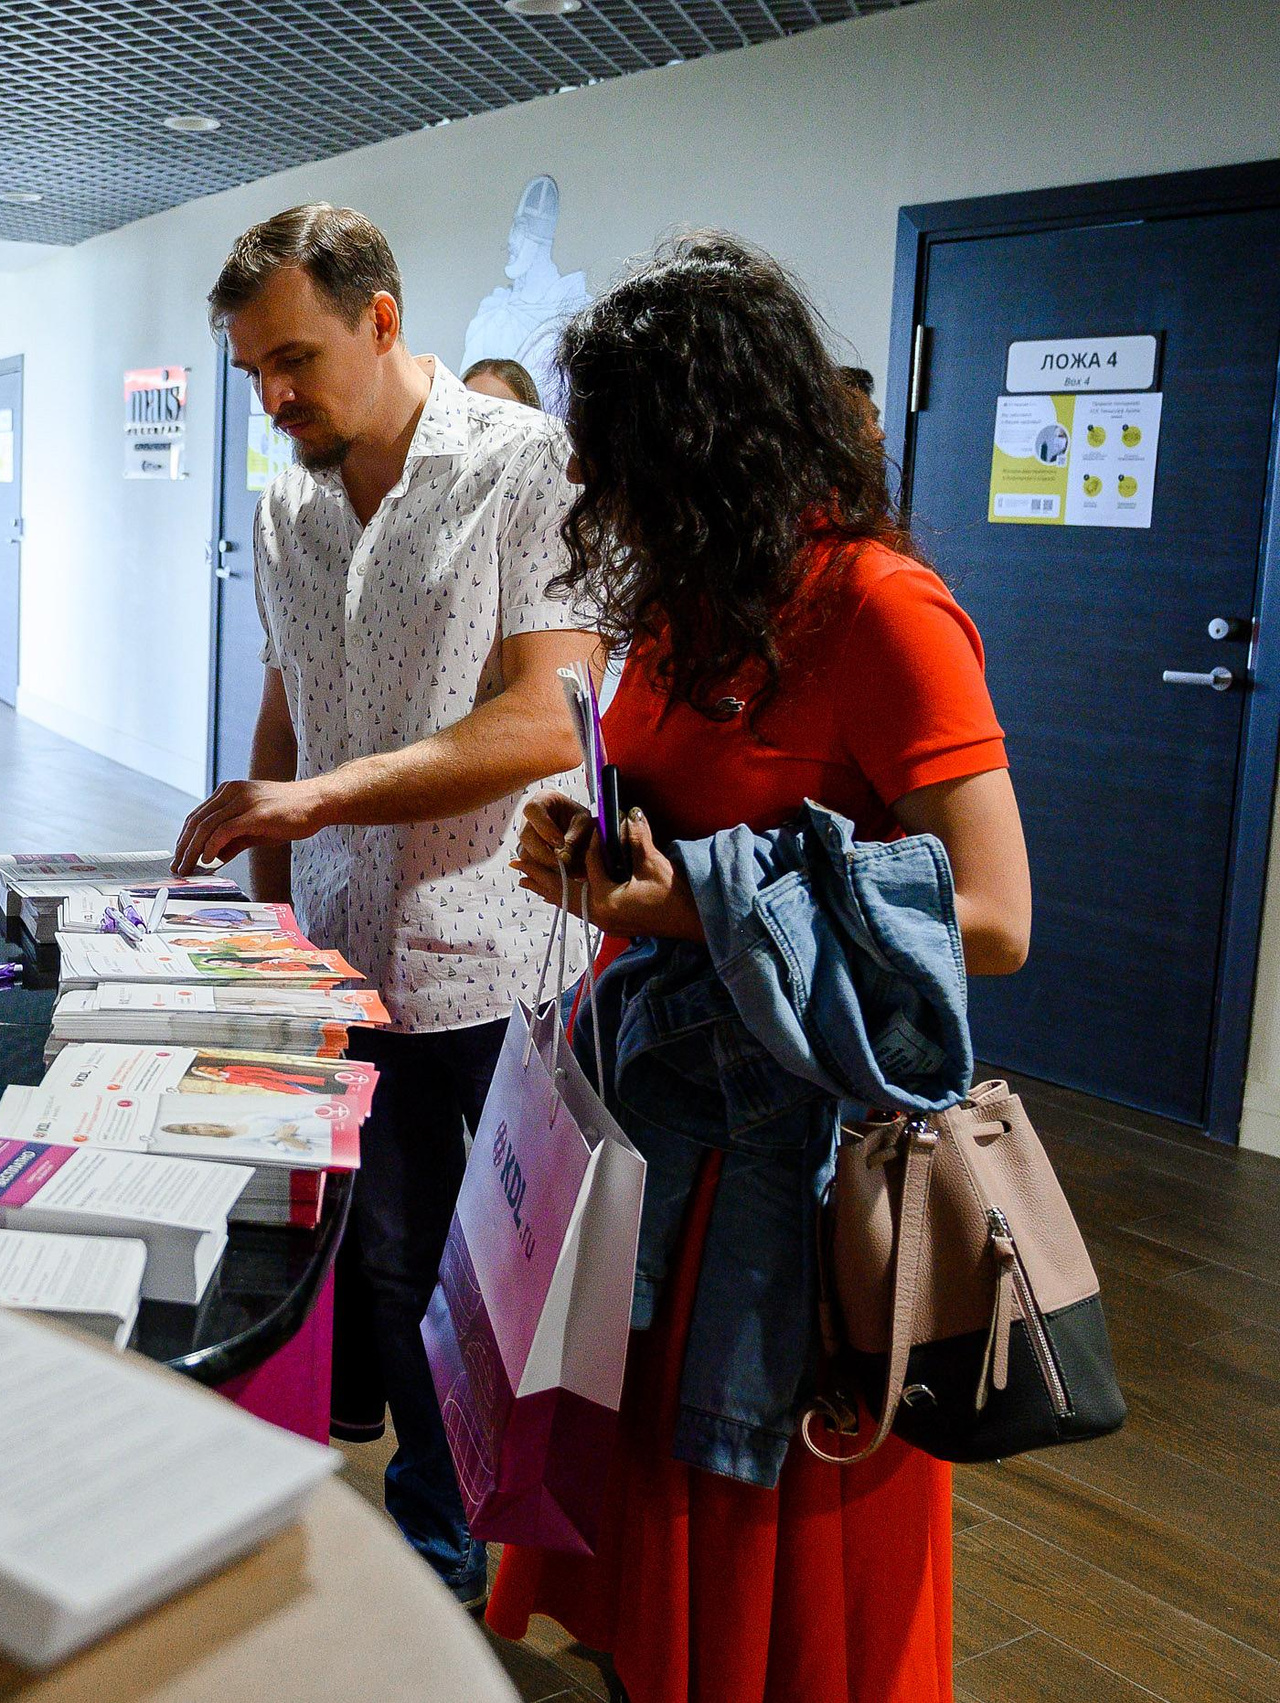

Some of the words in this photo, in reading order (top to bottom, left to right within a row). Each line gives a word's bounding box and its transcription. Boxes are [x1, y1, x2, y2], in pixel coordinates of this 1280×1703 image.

[1040, 351, 1101, 371] ЛОЖА
[1106, 350, 1118, 368] 4
[1063, 378, 1081, 387] Box
[1083, 376, 1091, 386] 4
